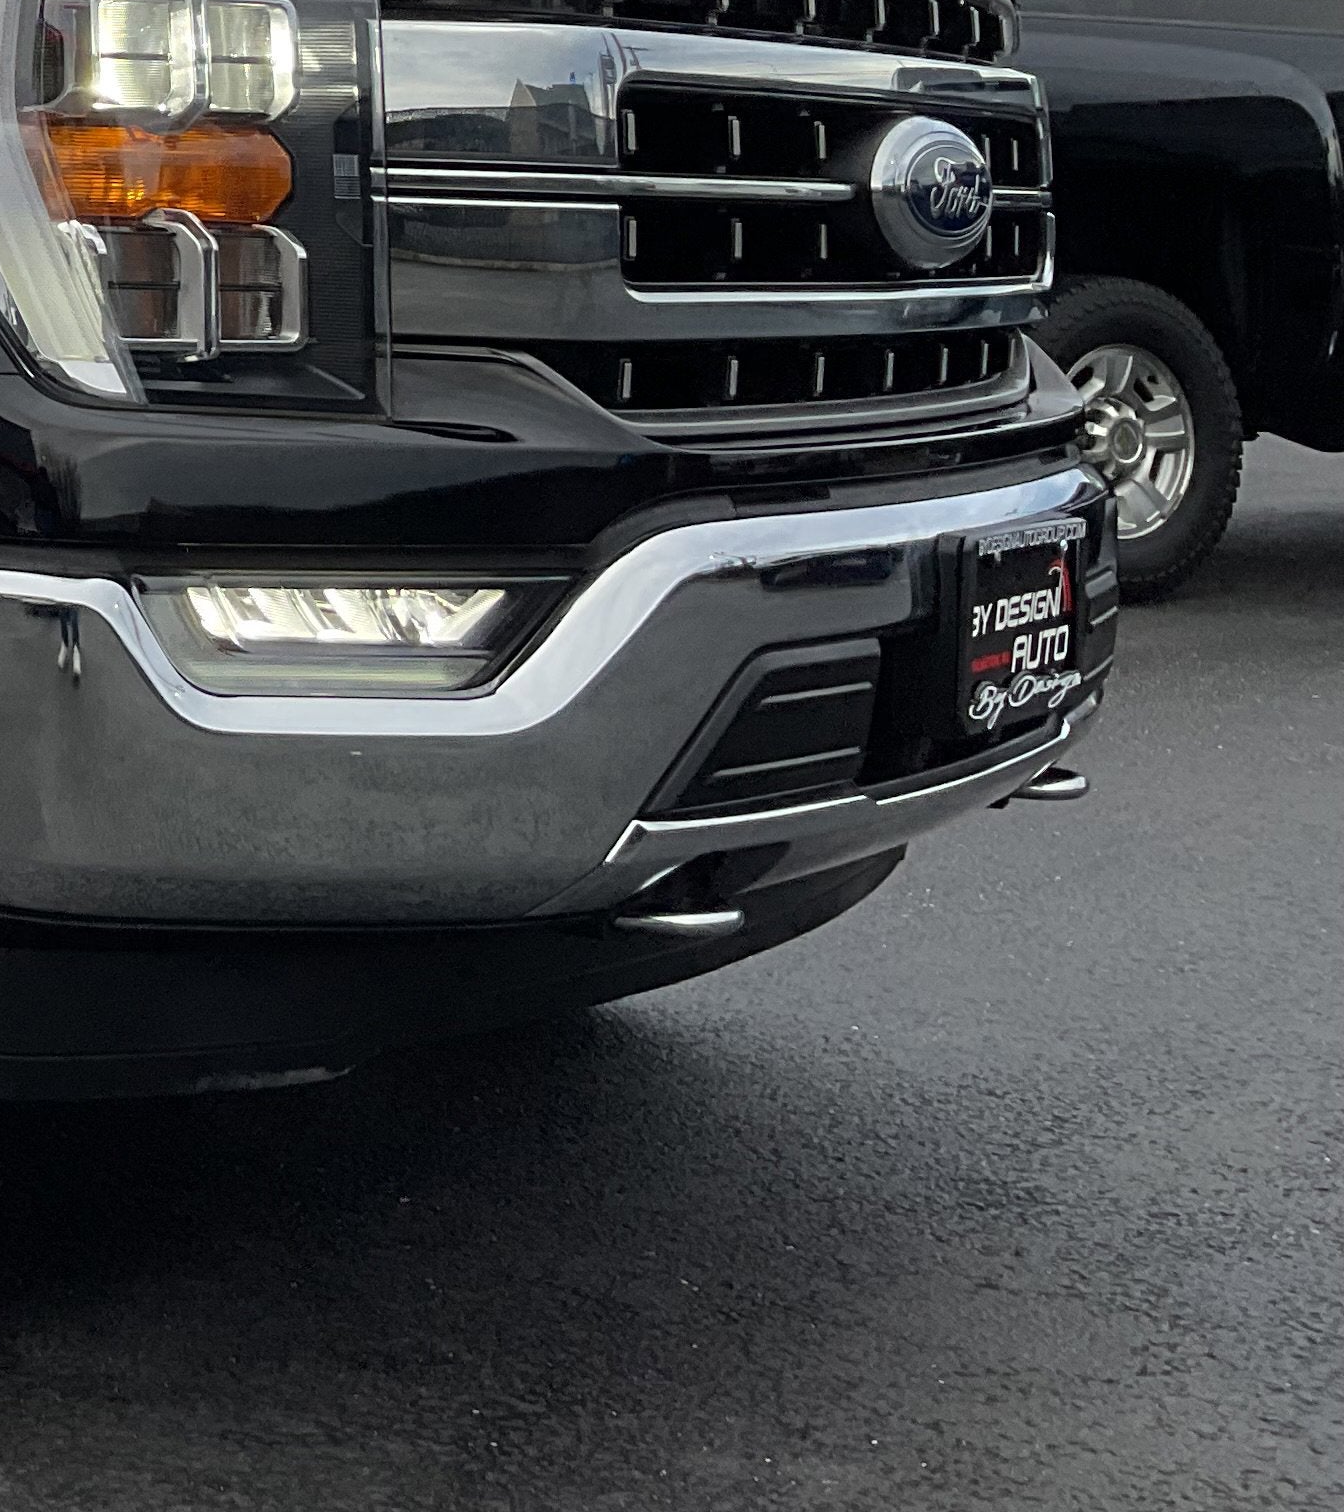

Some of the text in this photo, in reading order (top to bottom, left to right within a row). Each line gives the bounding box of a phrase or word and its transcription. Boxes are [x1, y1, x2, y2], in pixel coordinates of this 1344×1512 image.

[929, 156, 989, 219] Ford
[994, 586, 1062, 632] DESIGN
[1011, 624, 1070, 673] AUTO
[968, 683, 1008, 730] By
